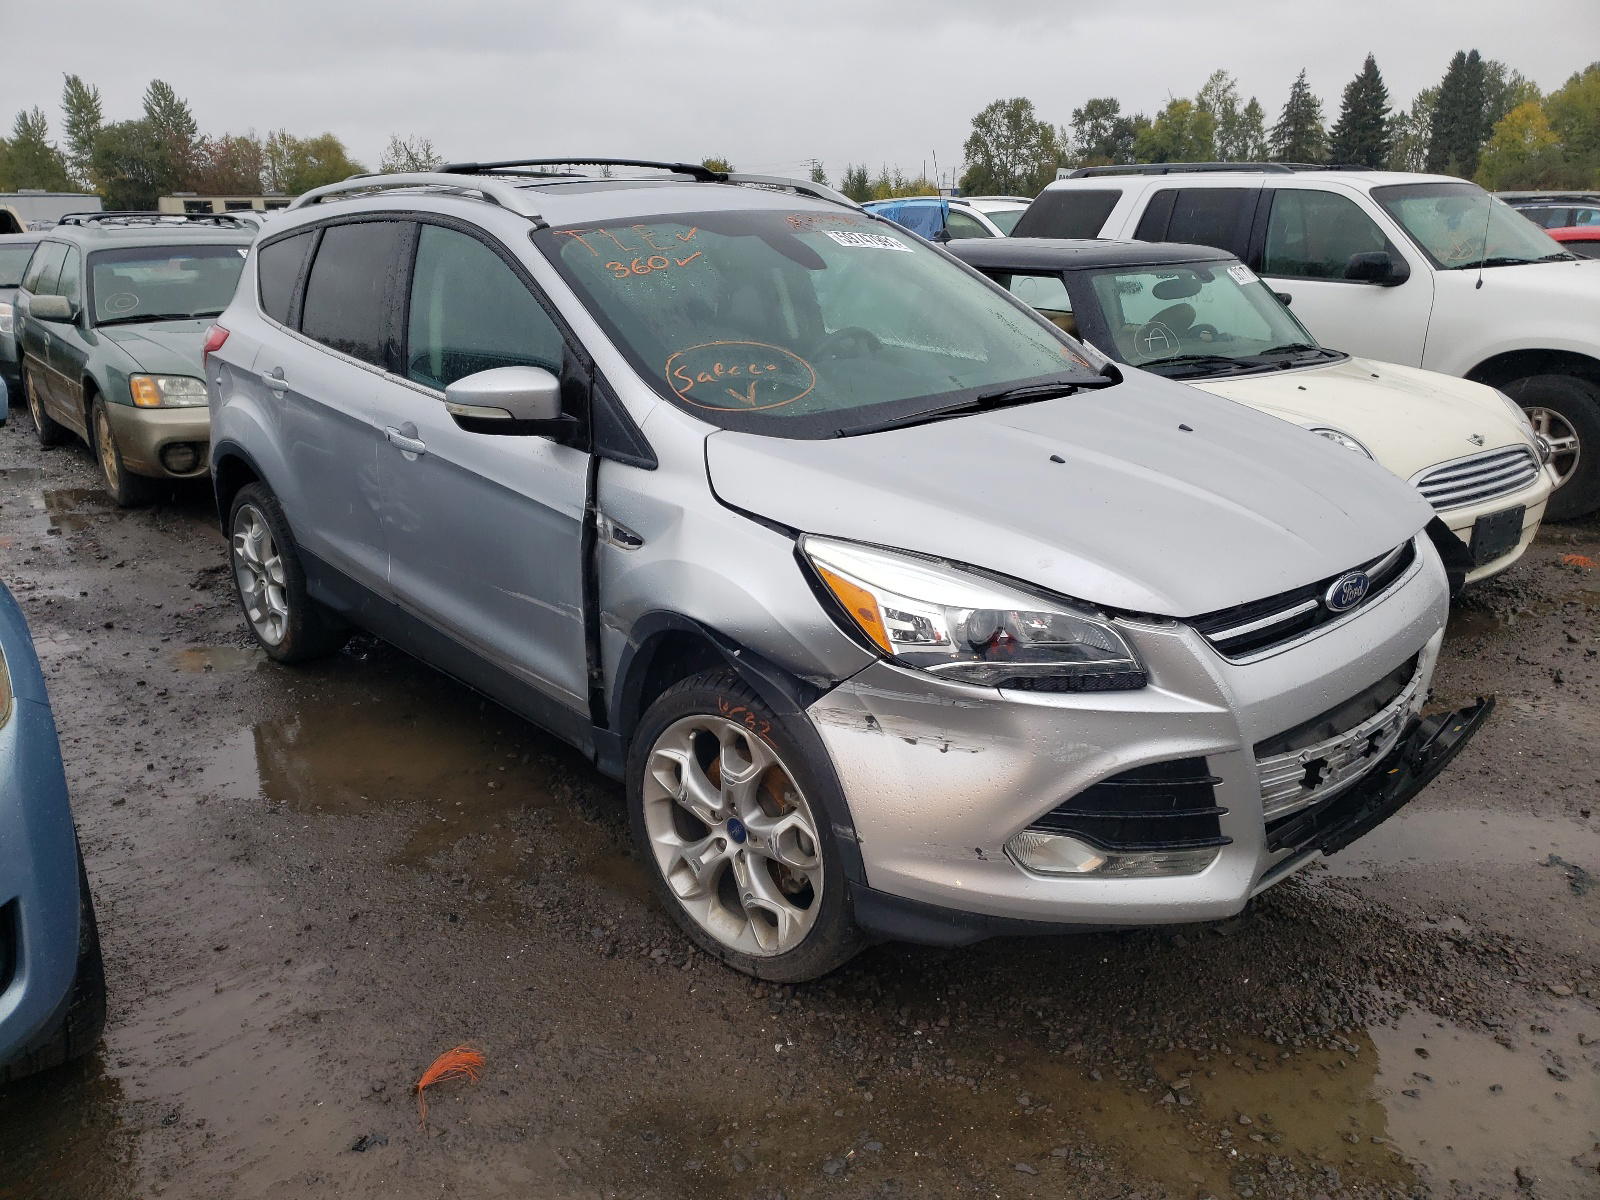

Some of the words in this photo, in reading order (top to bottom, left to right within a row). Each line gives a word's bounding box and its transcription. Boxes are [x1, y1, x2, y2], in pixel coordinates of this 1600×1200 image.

[606, 256, 669, 278] 360
[1144, 328, 1170, 352] A
[1341, 577, 1364, 604] Ford
